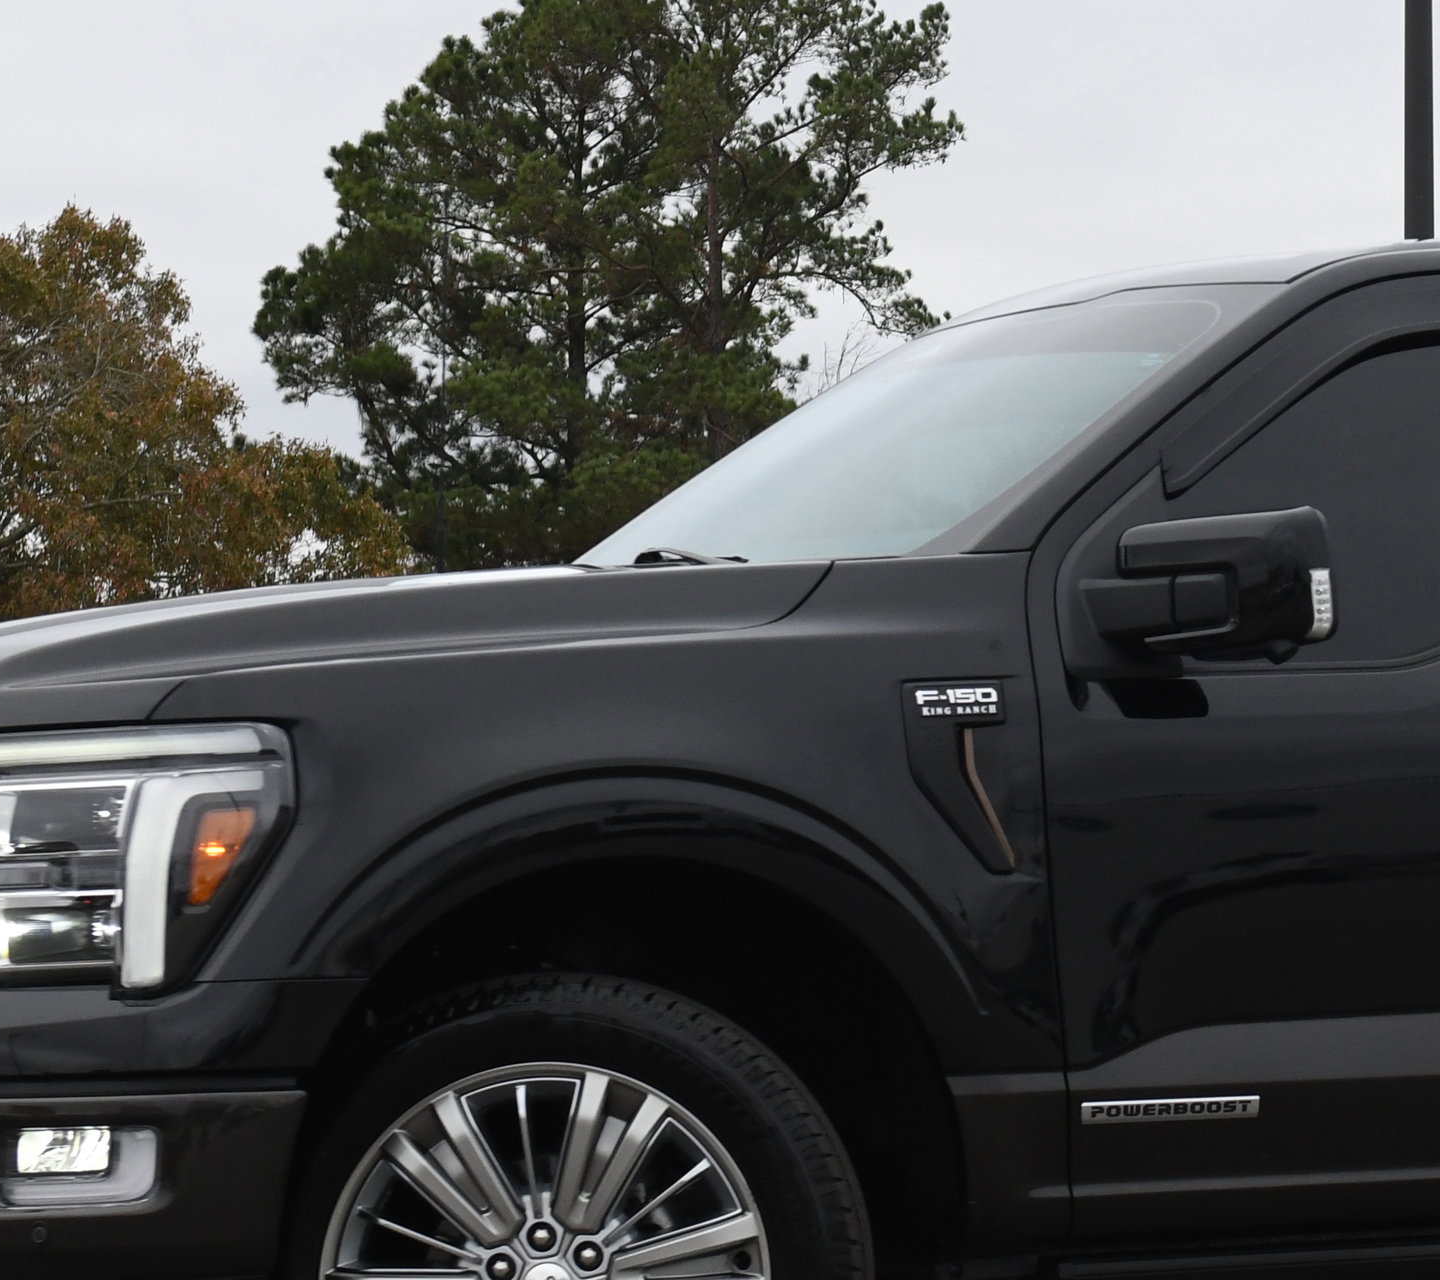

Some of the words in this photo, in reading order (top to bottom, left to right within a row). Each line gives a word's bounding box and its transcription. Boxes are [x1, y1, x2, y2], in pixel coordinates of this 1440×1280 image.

[914, 687, 999, 705] F-150
[921, 706, 952, 716] KING
[956, 704, 997, 715] RANCH
[1090, 1100, 1252, 1118] POWERBOOST
